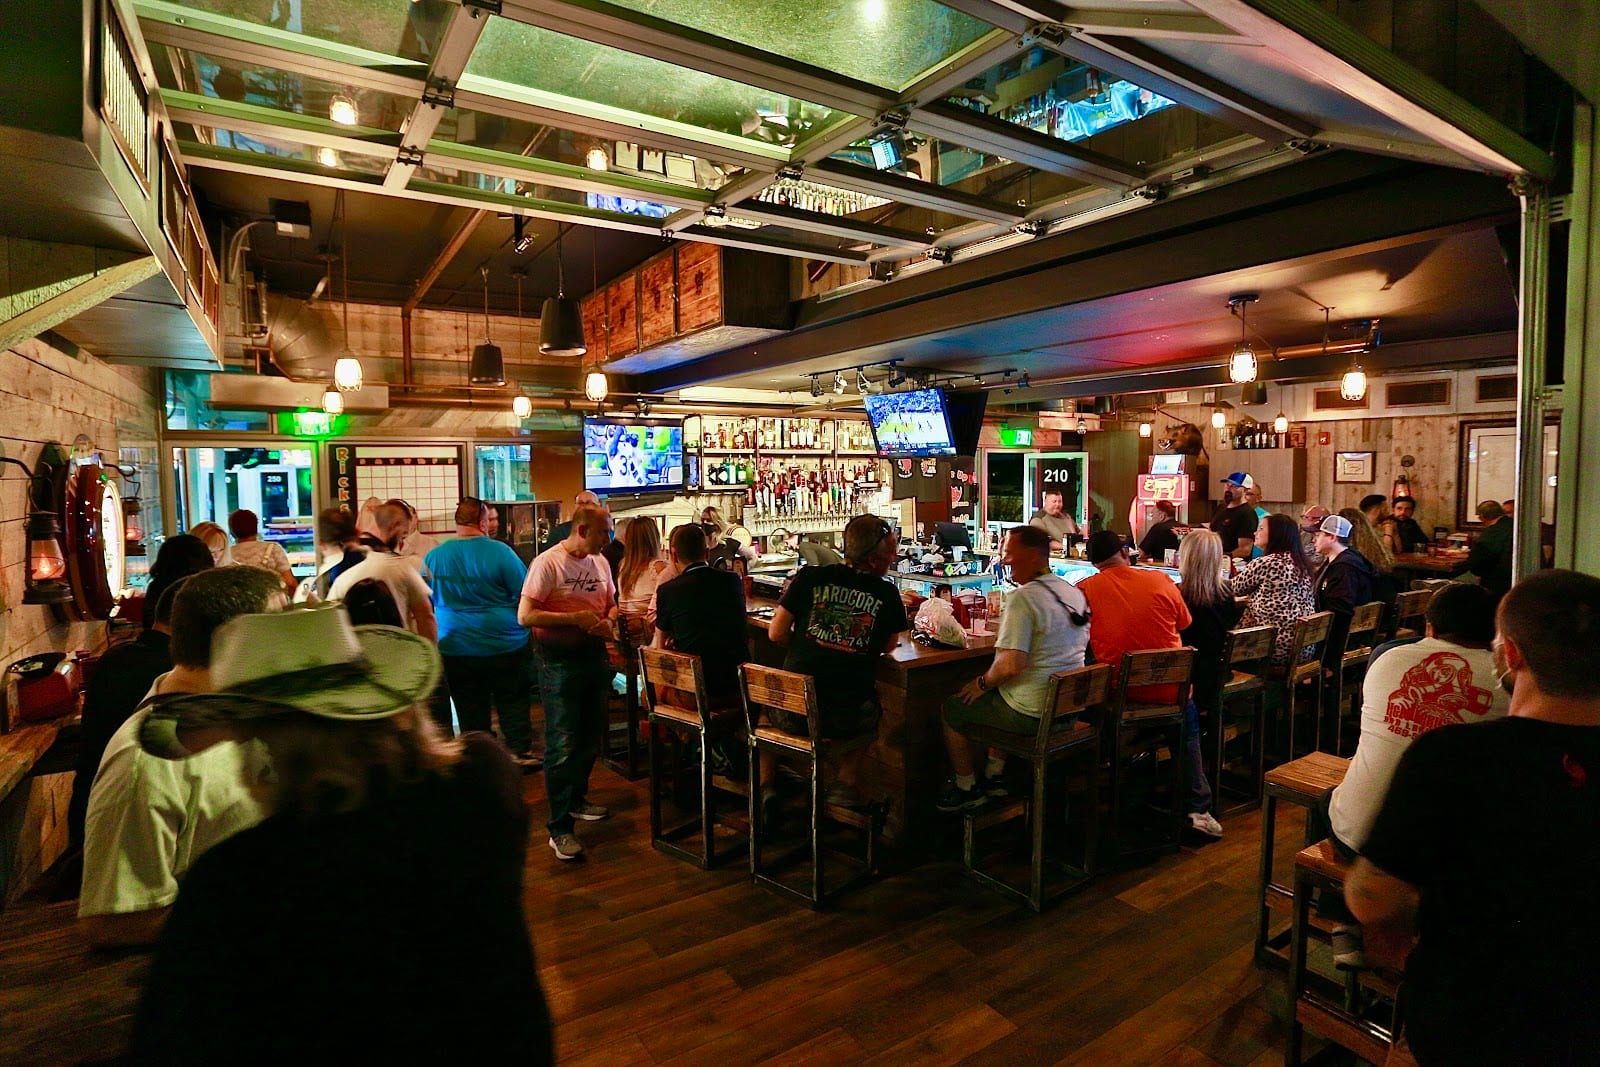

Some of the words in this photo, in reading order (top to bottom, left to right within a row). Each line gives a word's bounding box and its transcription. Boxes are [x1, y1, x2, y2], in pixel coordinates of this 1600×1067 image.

[1043, 469, 1069, 483] 210
[812, 585, 882, 617] HARDCORE
[810, 625, 843, 645] SINCE
